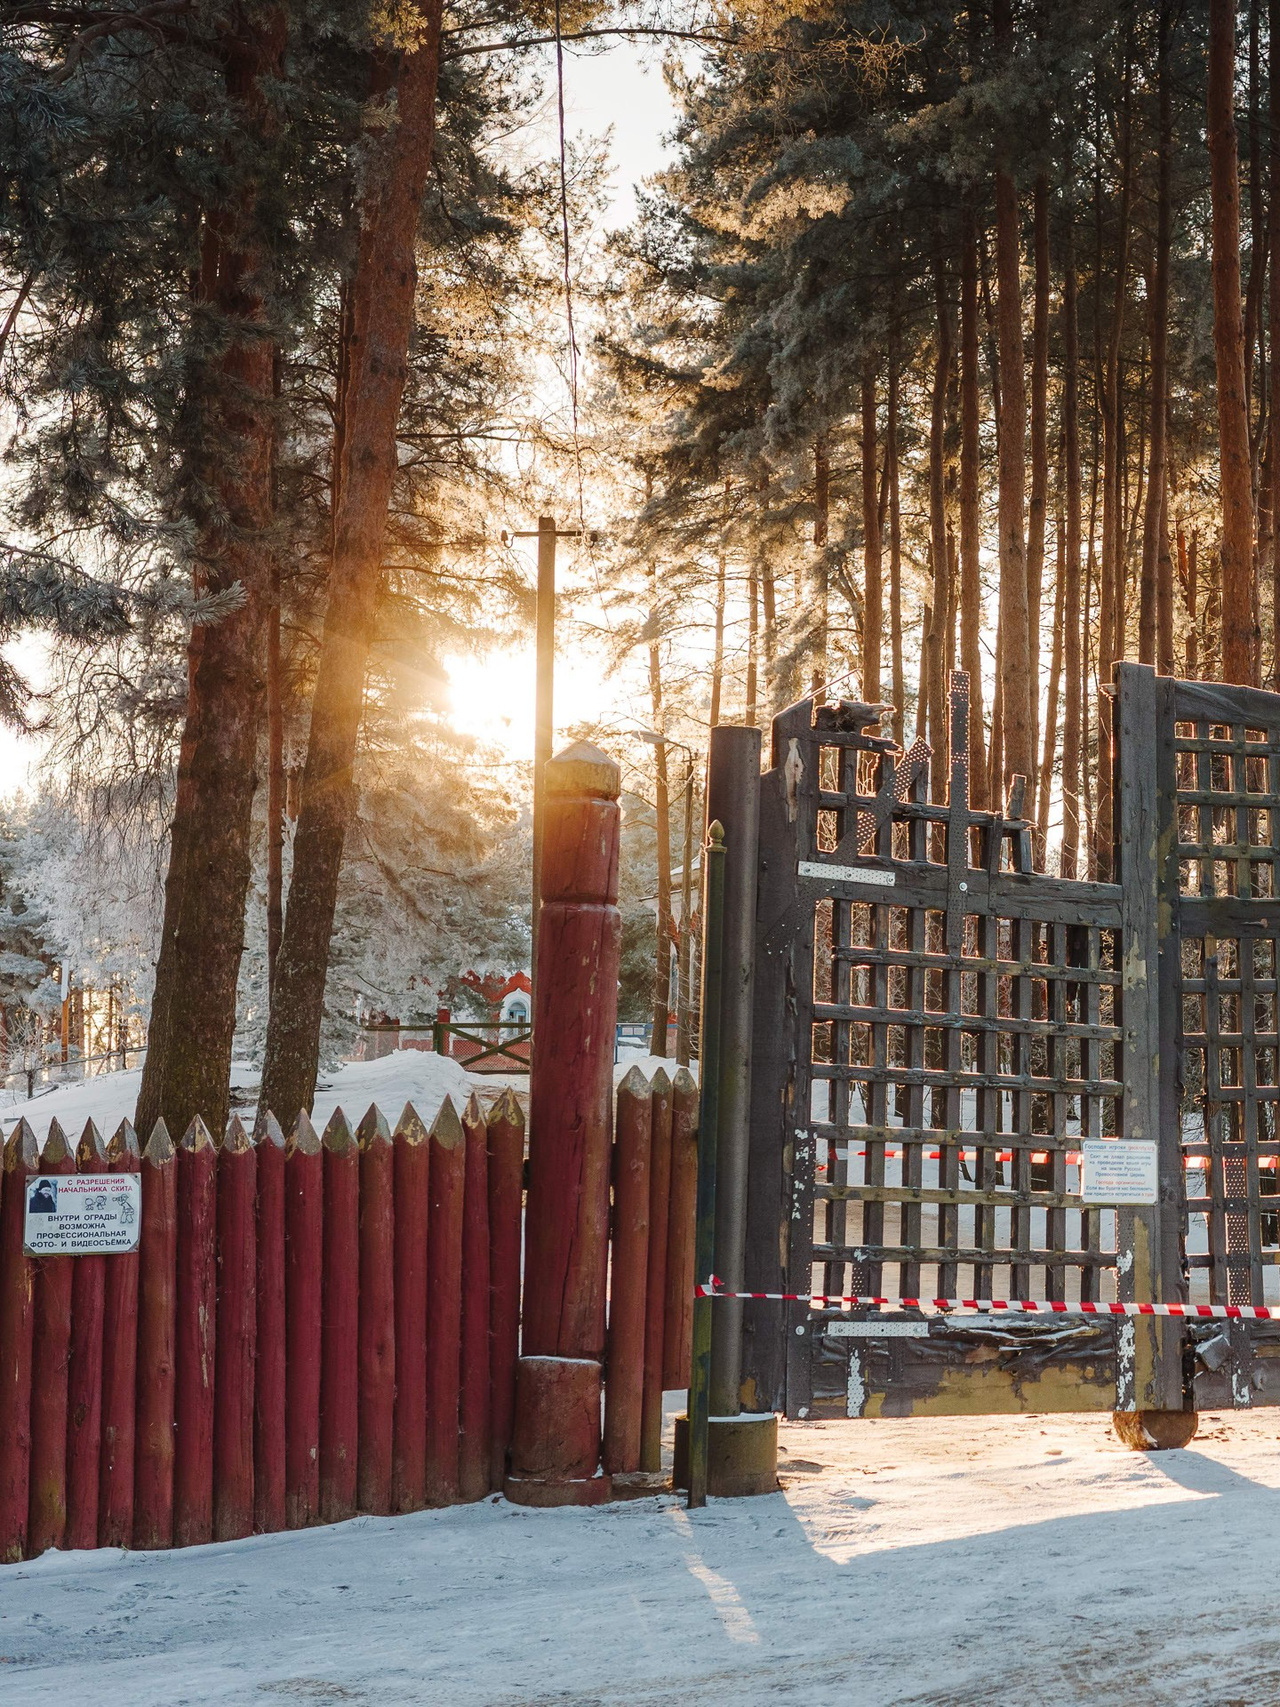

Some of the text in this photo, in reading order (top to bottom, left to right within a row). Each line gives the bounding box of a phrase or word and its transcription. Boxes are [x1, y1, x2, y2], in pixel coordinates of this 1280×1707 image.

[48, 1214, 80, 1222] ВНУТРИ
[36, 1231, 127, 1239] ПРОФЕССИОНАЛЬНАЯ
[71, 1239, 132, 1247] ВИДЕОСЪЁМКА
